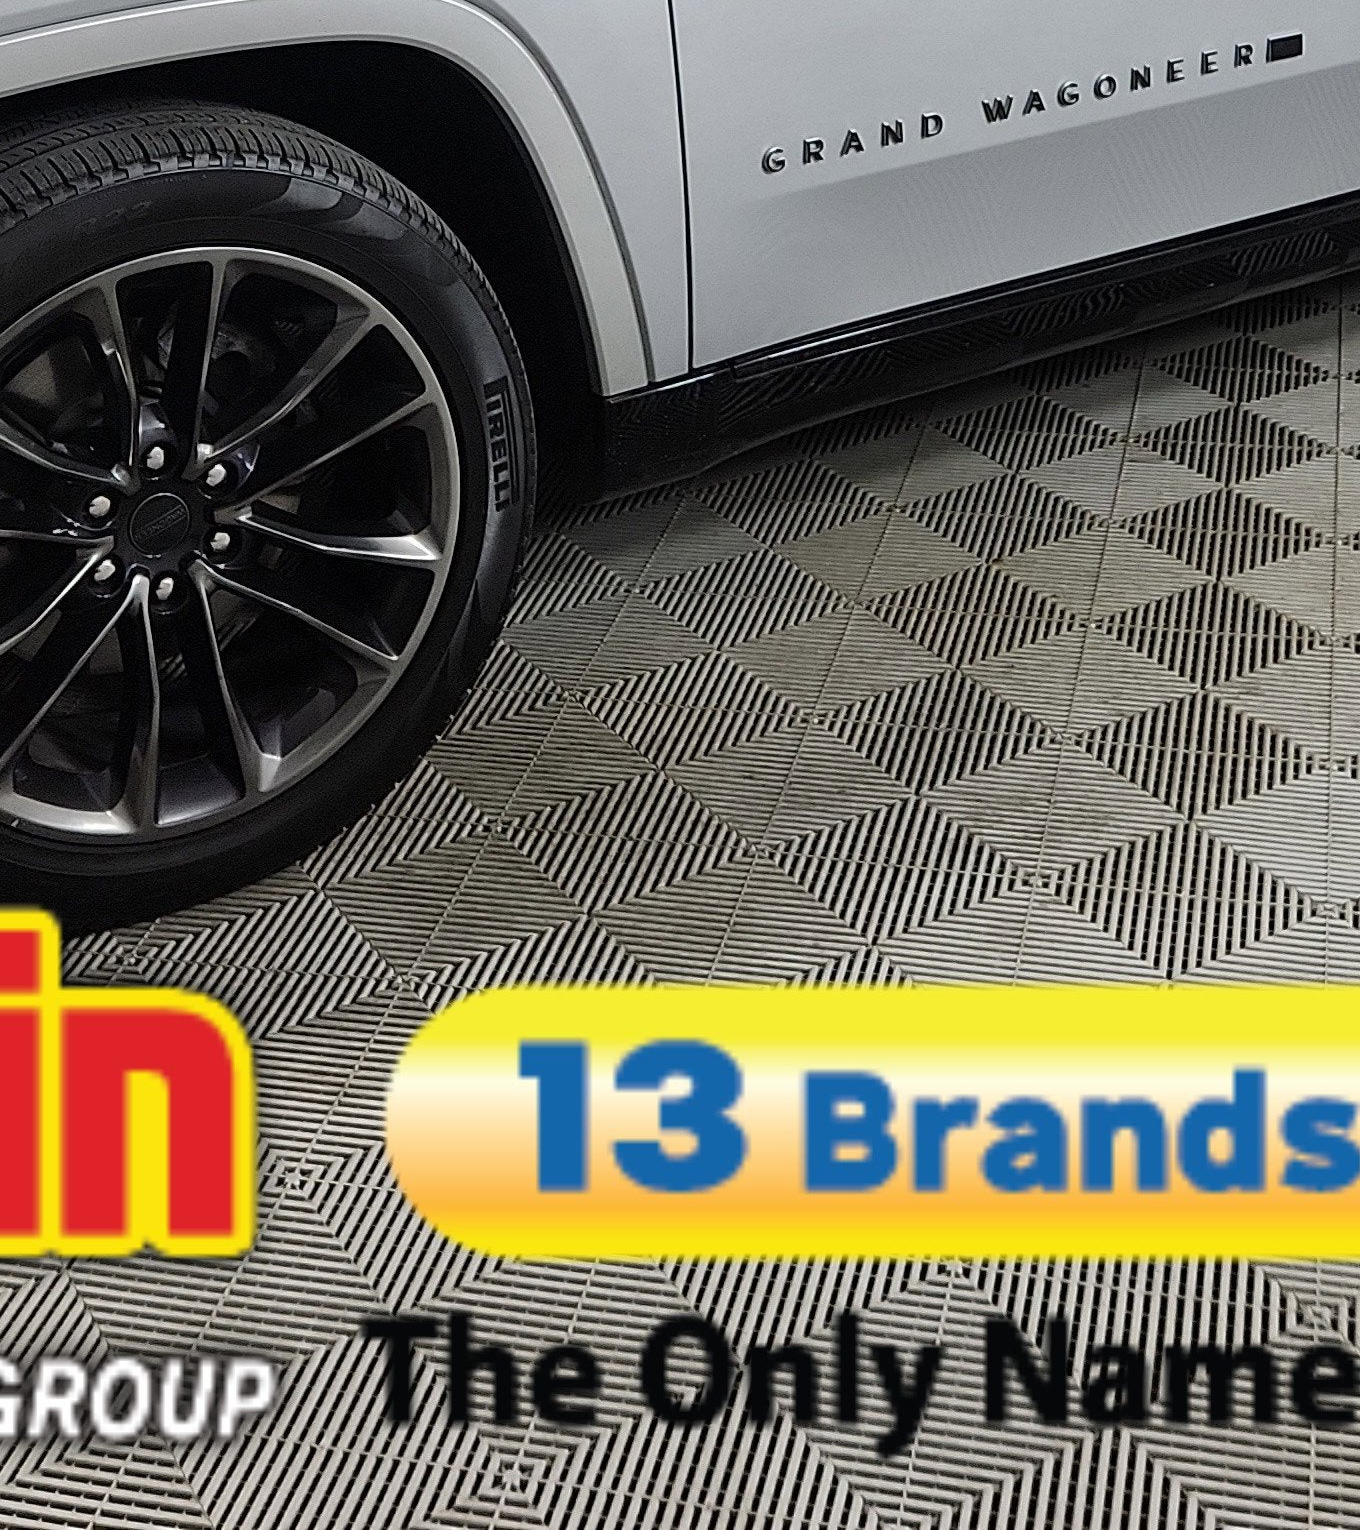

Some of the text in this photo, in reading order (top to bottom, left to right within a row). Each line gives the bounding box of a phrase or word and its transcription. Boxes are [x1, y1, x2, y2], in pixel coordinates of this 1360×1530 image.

[761, 43, 1255, 174] GRAND WAGONEER
[483, 376, 520, 512] PIRELLI
